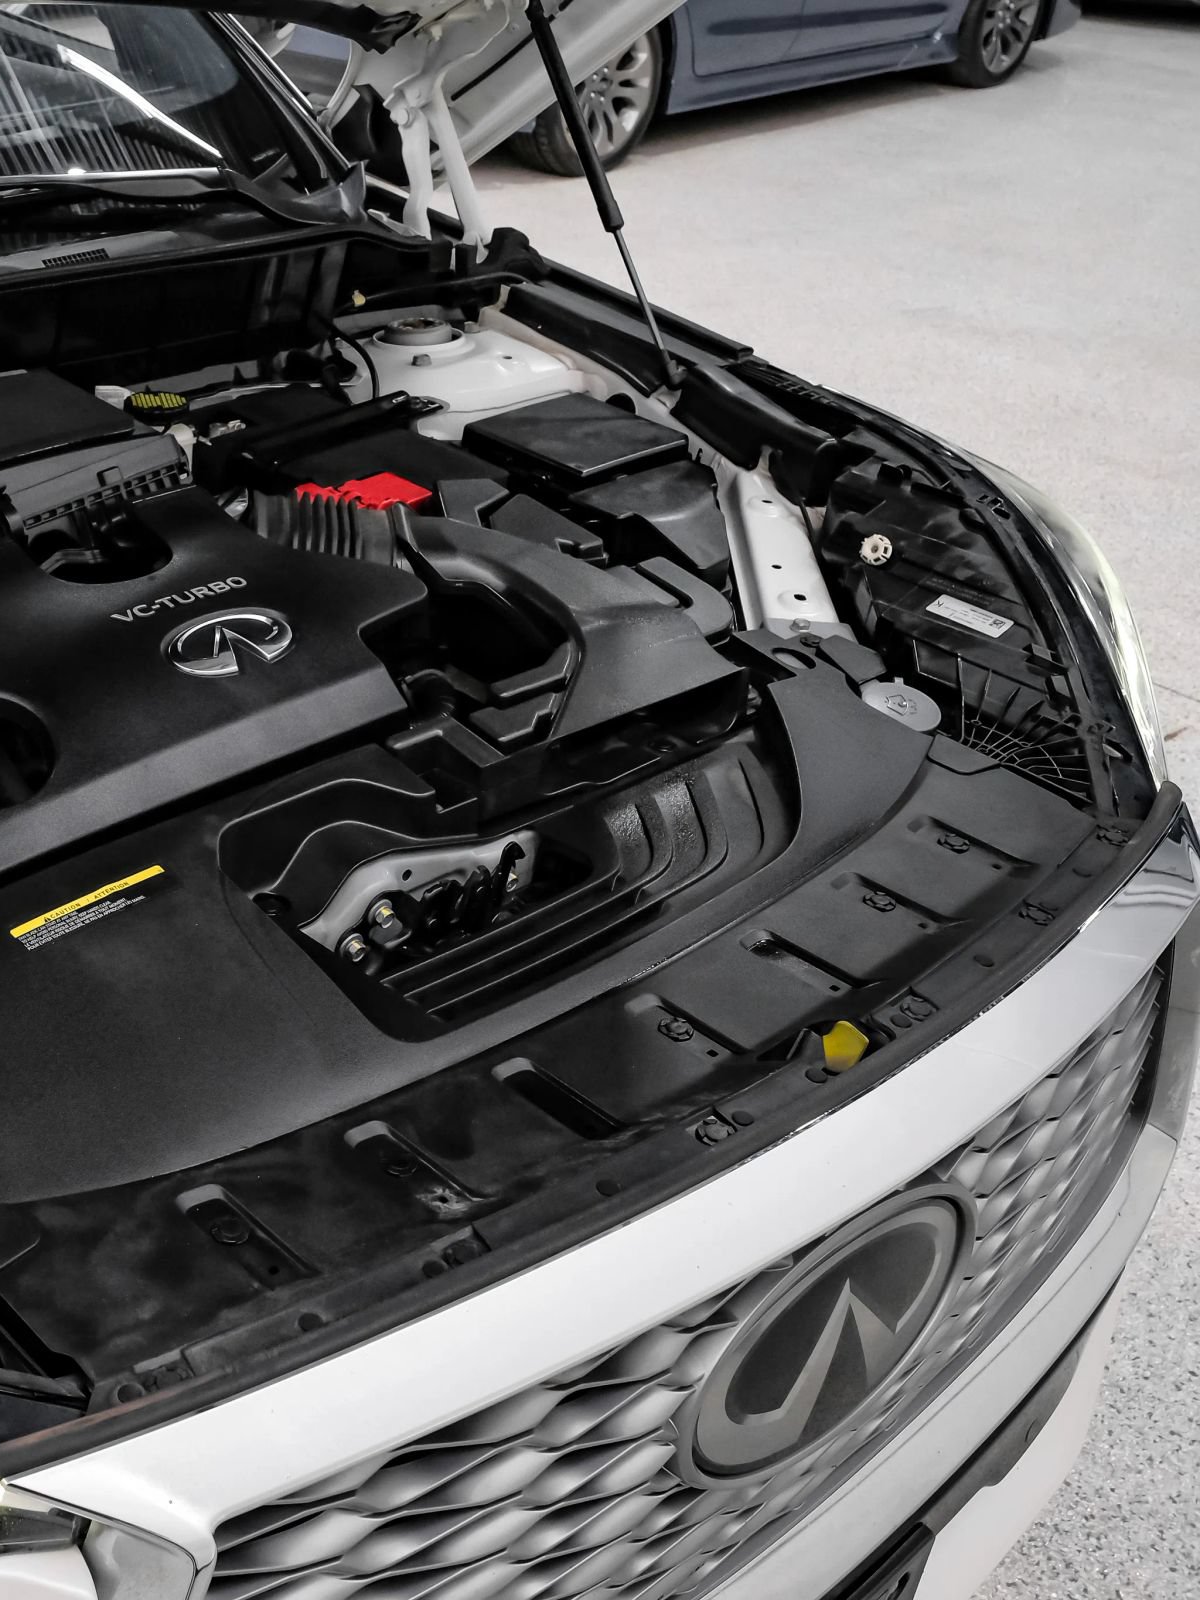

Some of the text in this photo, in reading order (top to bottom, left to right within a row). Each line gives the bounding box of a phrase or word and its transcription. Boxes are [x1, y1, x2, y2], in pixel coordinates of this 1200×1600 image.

[110, 576, 247, 622] VC-TURBO
[51, 903, 81, 918] CAUTION
[93, 881, 129, 899] ATTENTION
[52, 931, 66, 939] TOUTE
[102, 903, 126, 916] APPROCHER
